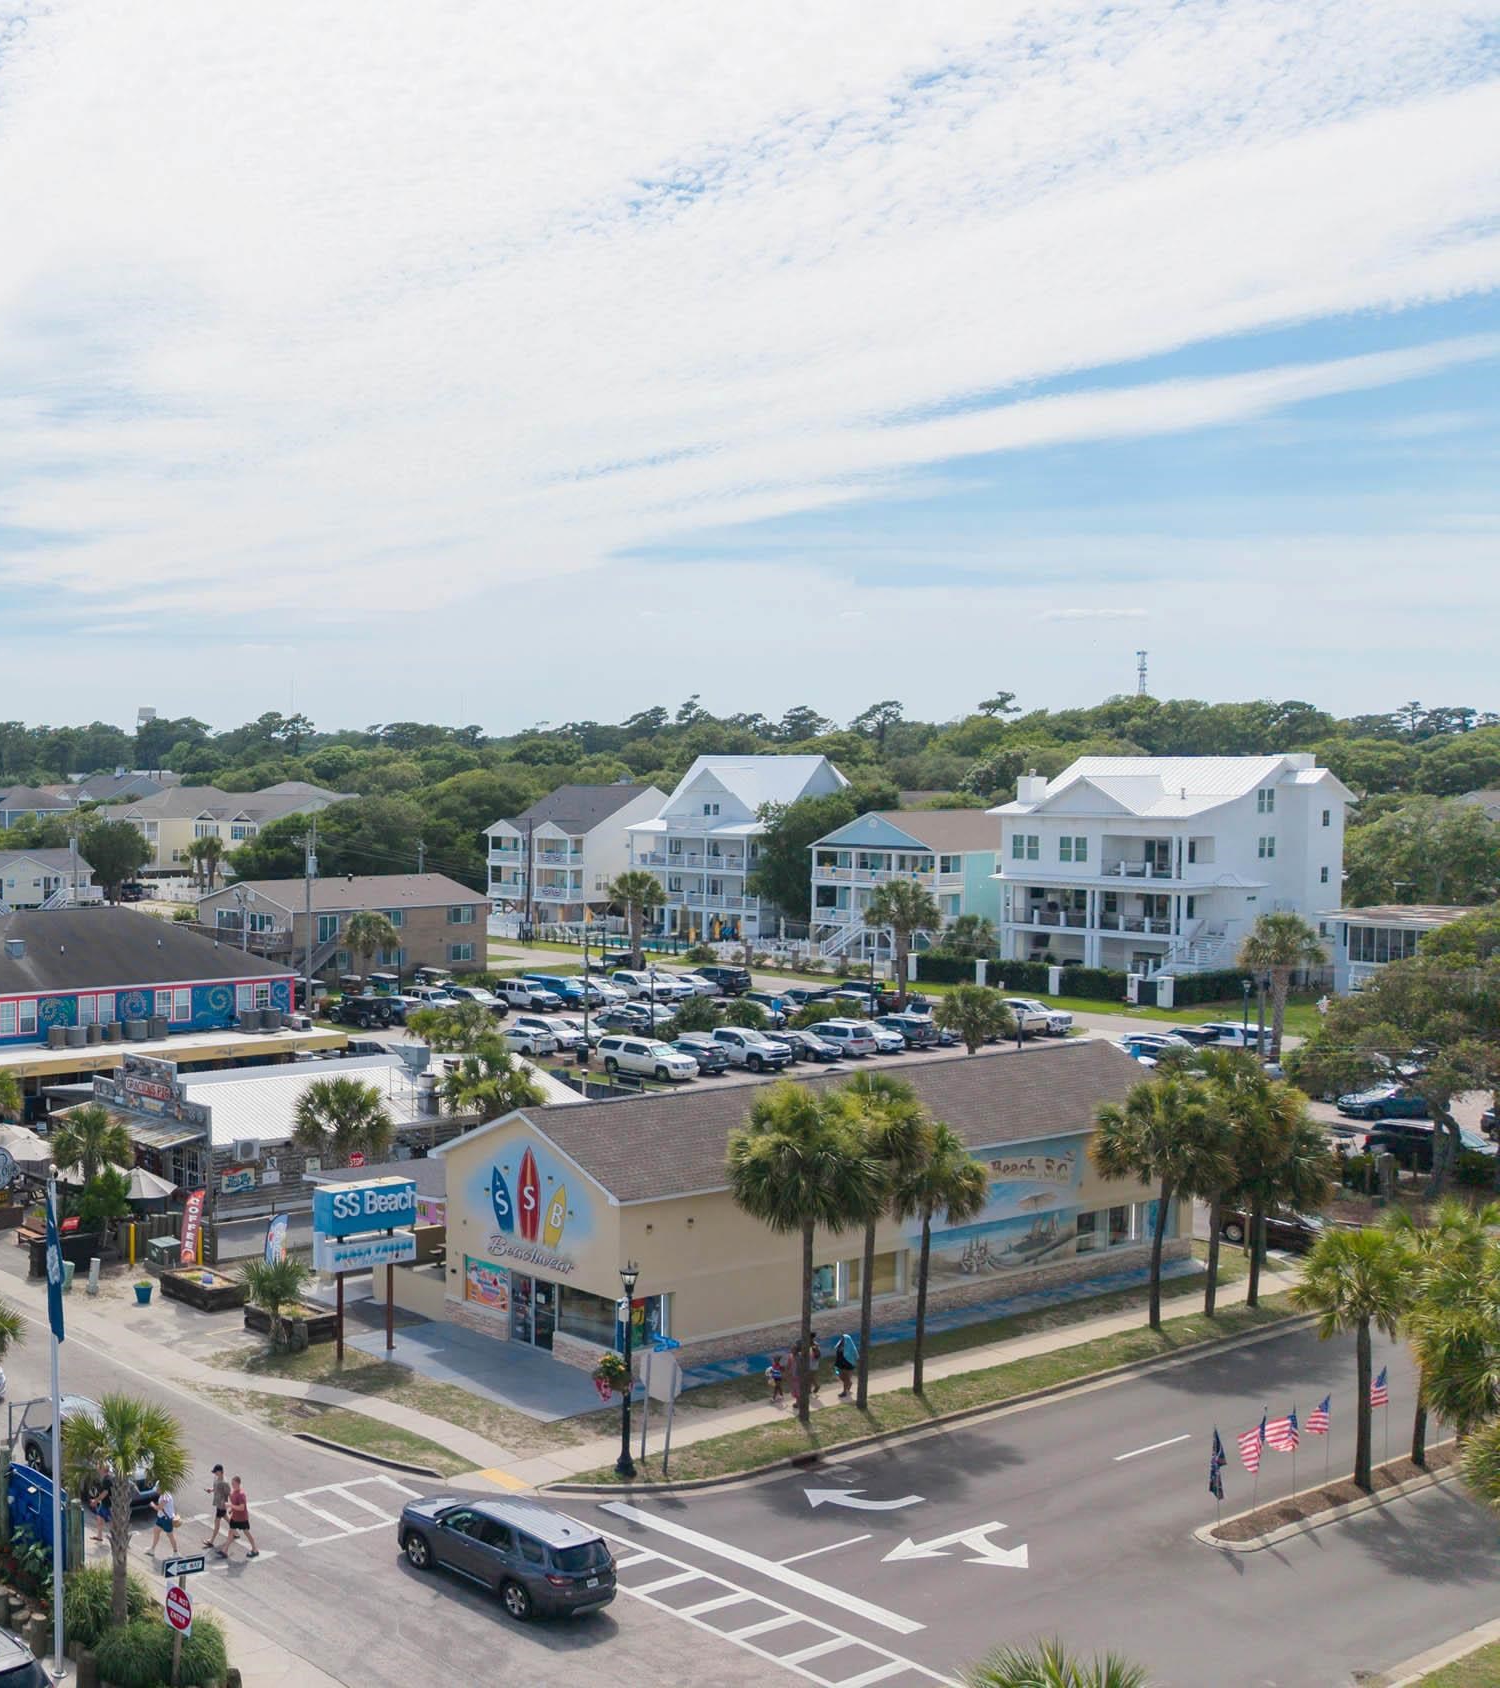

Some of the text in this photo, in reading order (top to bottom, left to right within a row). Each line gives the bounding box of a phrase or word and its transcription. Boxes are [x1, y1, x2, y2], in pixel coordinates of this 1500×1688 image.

[126, 1078, 171, 1099] GRACIOUS PIG
[333, 1193, 360, 1218] SS
[364, 1185, 417, 1215] Beach
[495, 1186, 564, 1227] S S B
[185, 1197, 200, 1251] COFFEE
[487, 1234, 575, 1275] Beachwear
[169, 1591, 189, 1608] DO NOT
[170, 1610, 186, 1624] ENTER
